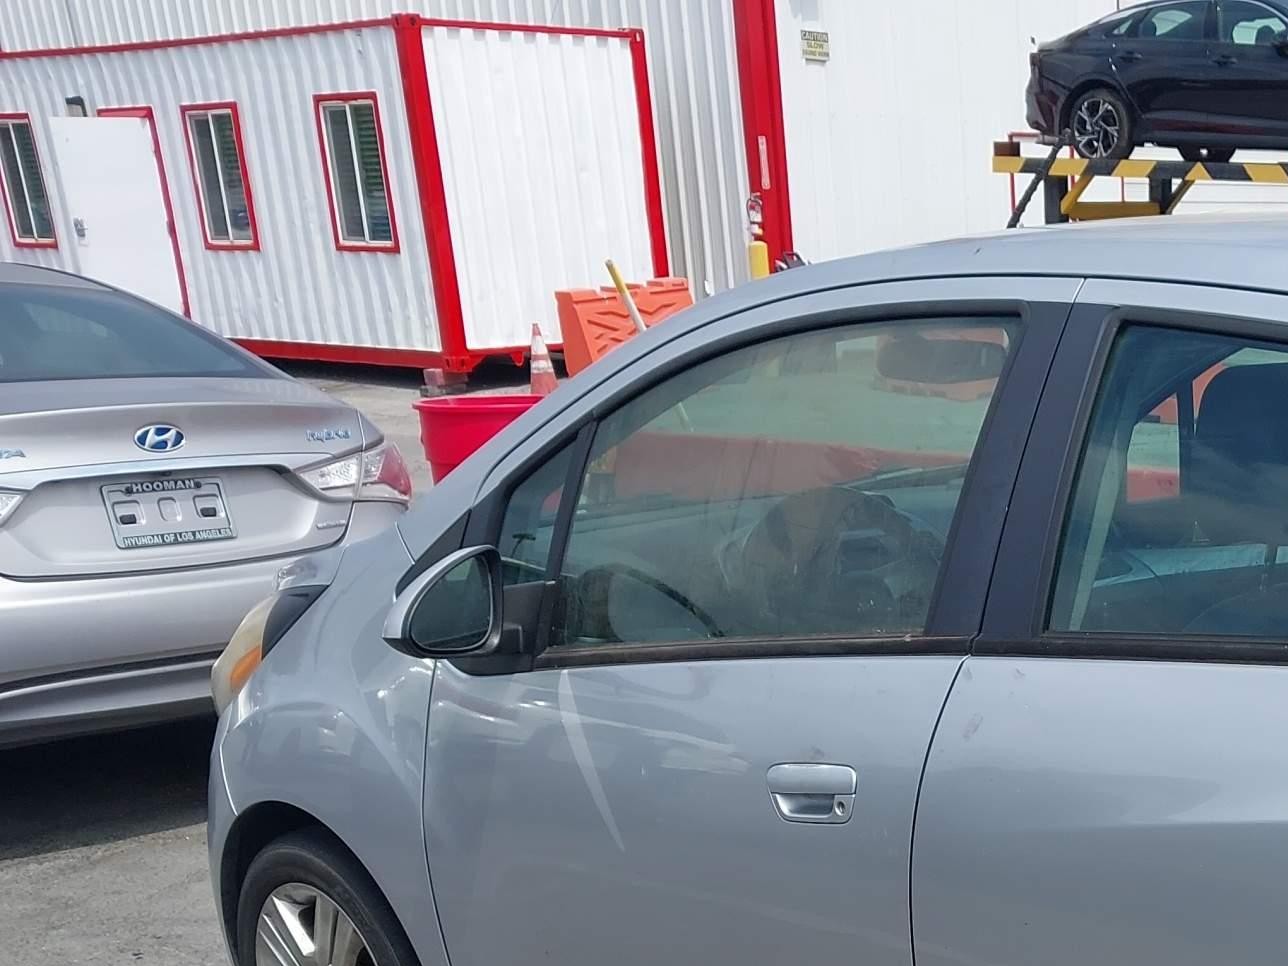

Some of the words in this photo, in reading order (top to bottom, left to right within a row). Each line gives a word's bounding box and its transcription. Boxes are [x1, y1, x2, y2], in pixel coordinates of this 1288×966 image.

[132, 479, 195, 493] HOOMAN
[123, 536, 162, 548] HYUNDAI
[164, 533, 175, 543] OF
[178, 531, 193, 542] LOS
[195, 528, 232, 541] ANGELES
